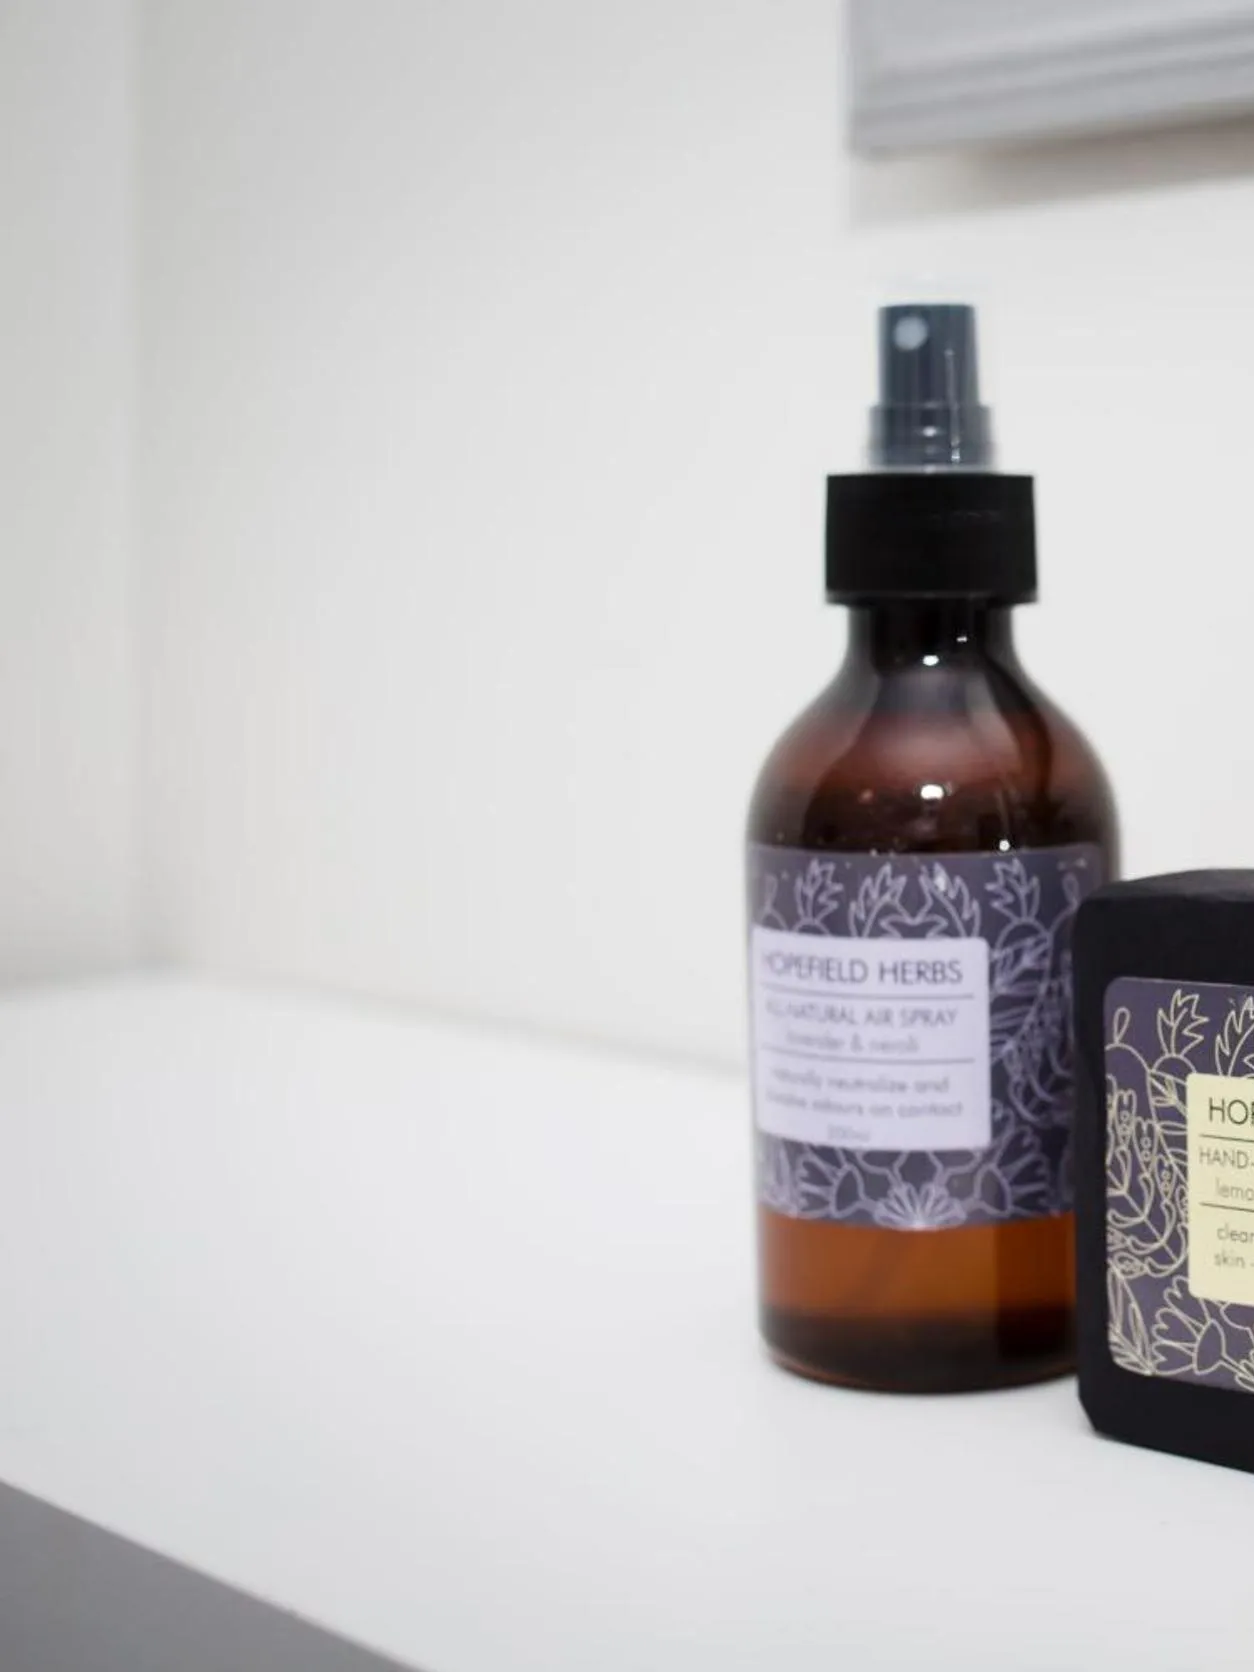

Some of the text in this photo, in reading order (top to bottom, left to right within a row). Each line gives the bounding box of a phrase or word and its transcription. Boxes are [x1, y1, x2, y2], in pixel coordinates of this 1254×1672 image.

[878, 959, 963, 985] HERBS
[864, 1009, 894, 1027] AIR
[901, 1009, 958, 1028] SPRAY
[915, 1077, 950, 1094] and
[1214, 1252, 1246, 1269] skin
